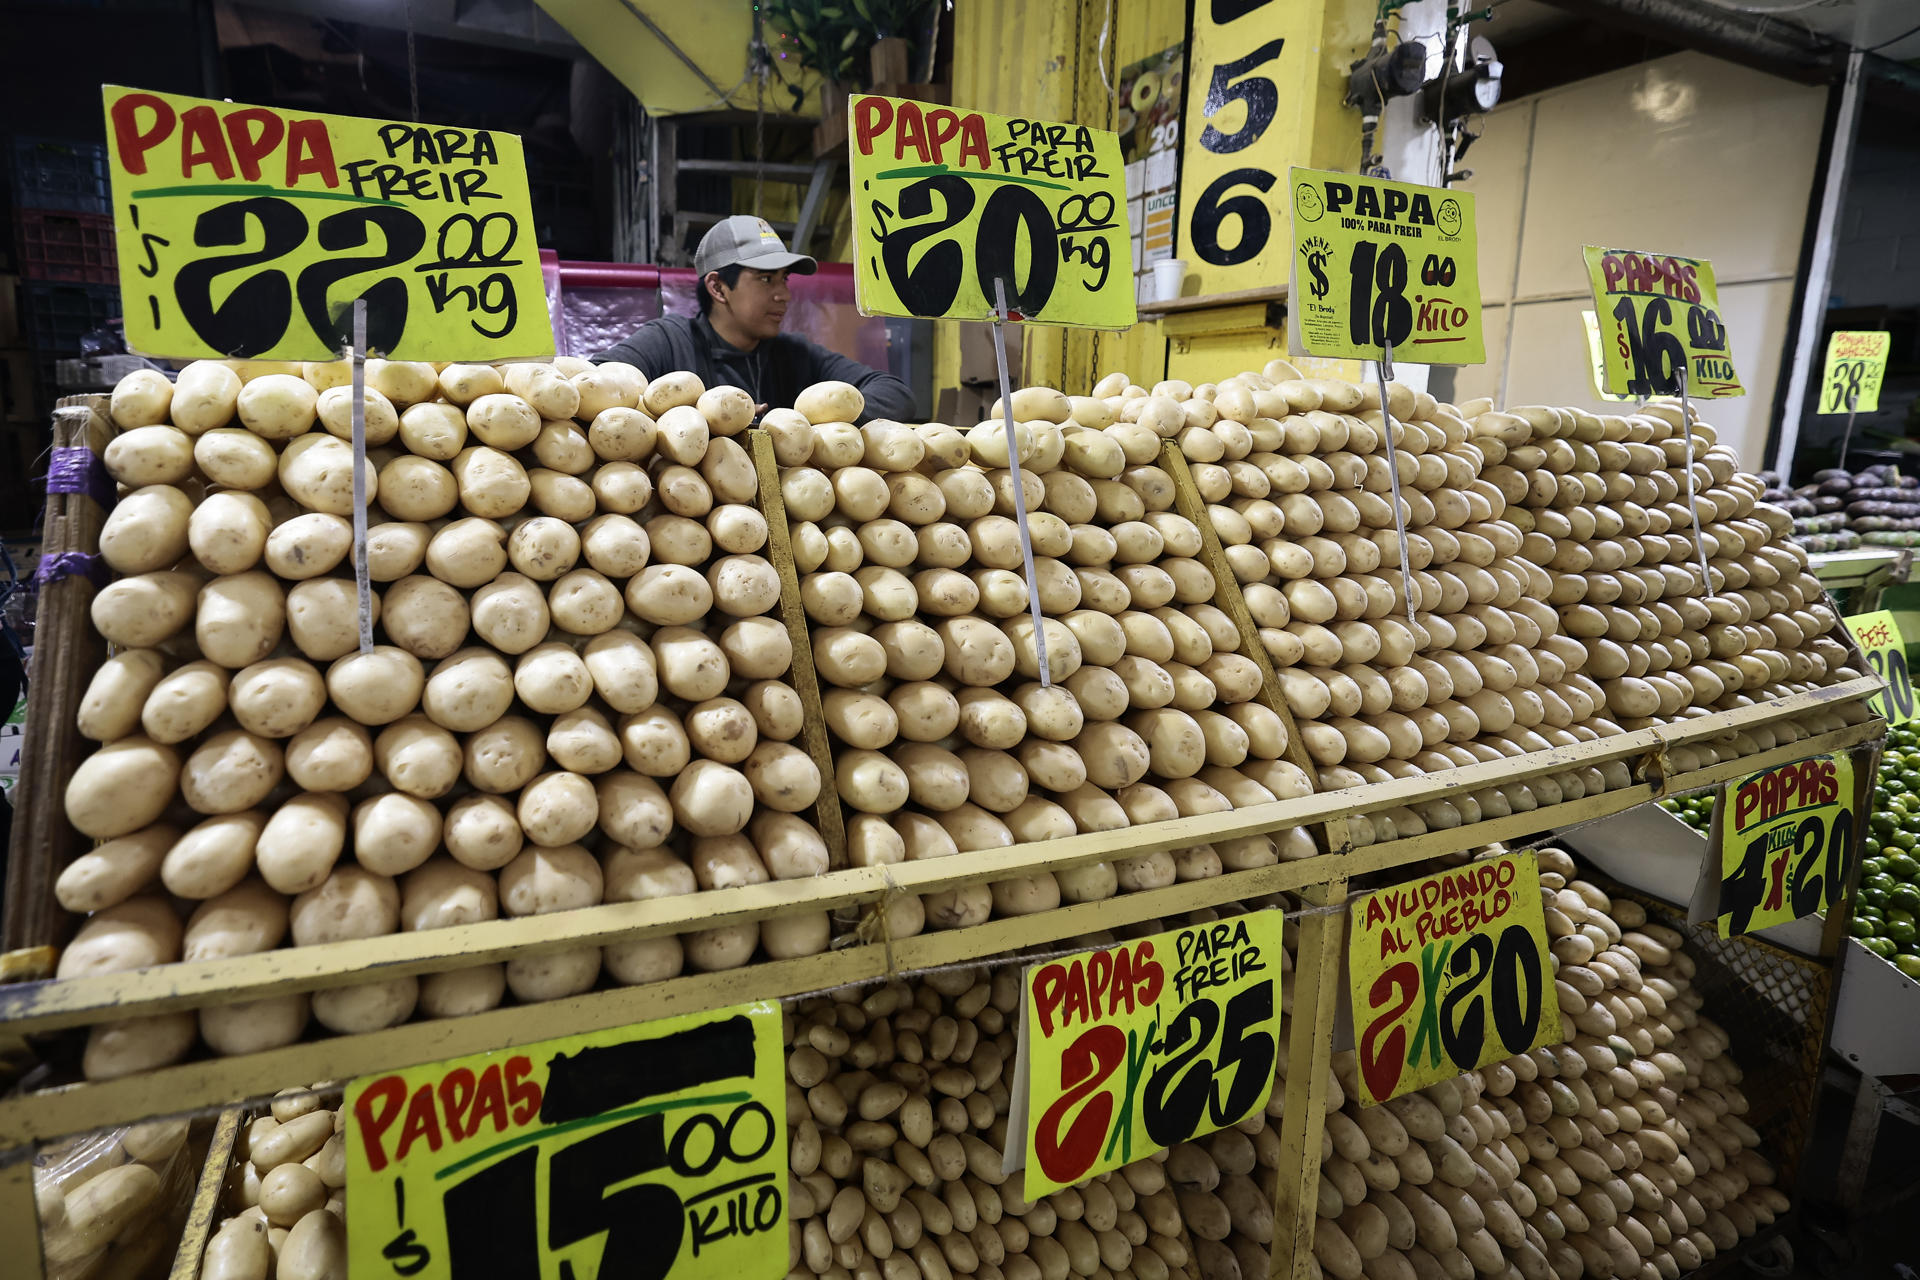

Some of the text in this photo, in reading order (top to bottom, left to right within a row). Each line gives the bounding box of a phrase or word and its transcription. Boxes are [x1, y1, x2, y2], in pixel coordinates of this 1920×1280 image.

[111, 93, 498, 188] PAPA PARA
[855, 97, 1094, 170] PAPA PARA
[340, 160, 502, 205] FREIR
[992, 142, 1109, 181] FREIR
[1057, 191, 1115, 229] 00
[1324, 182, 1435, 226] PAPA
[1341, 217, 1422, 238] 100% PARA FREIR
[437, 212, 518, 266] 00
[1300, 236, 1334, 258] JIMENEZ
[1421, 254, 1456, 287] 00
[1602, 254, 1701, 304] PAPAS
[1688, 306, 1725, 350] 00
[1696, 358, 1734, 380] KILO
[1735, 760, 1838, 831] PAPAS
[1381, 928, 1413, 960] AL
[1032, 920, 1250, 1038] PAPAS PARA
[1173, 946, 1266, 1003] FREIR
[354, 1056, 542, 1172] PAPAS
[668, 1102, 776, 1177] 00
[688, 1185, 782, 1257] KILO
